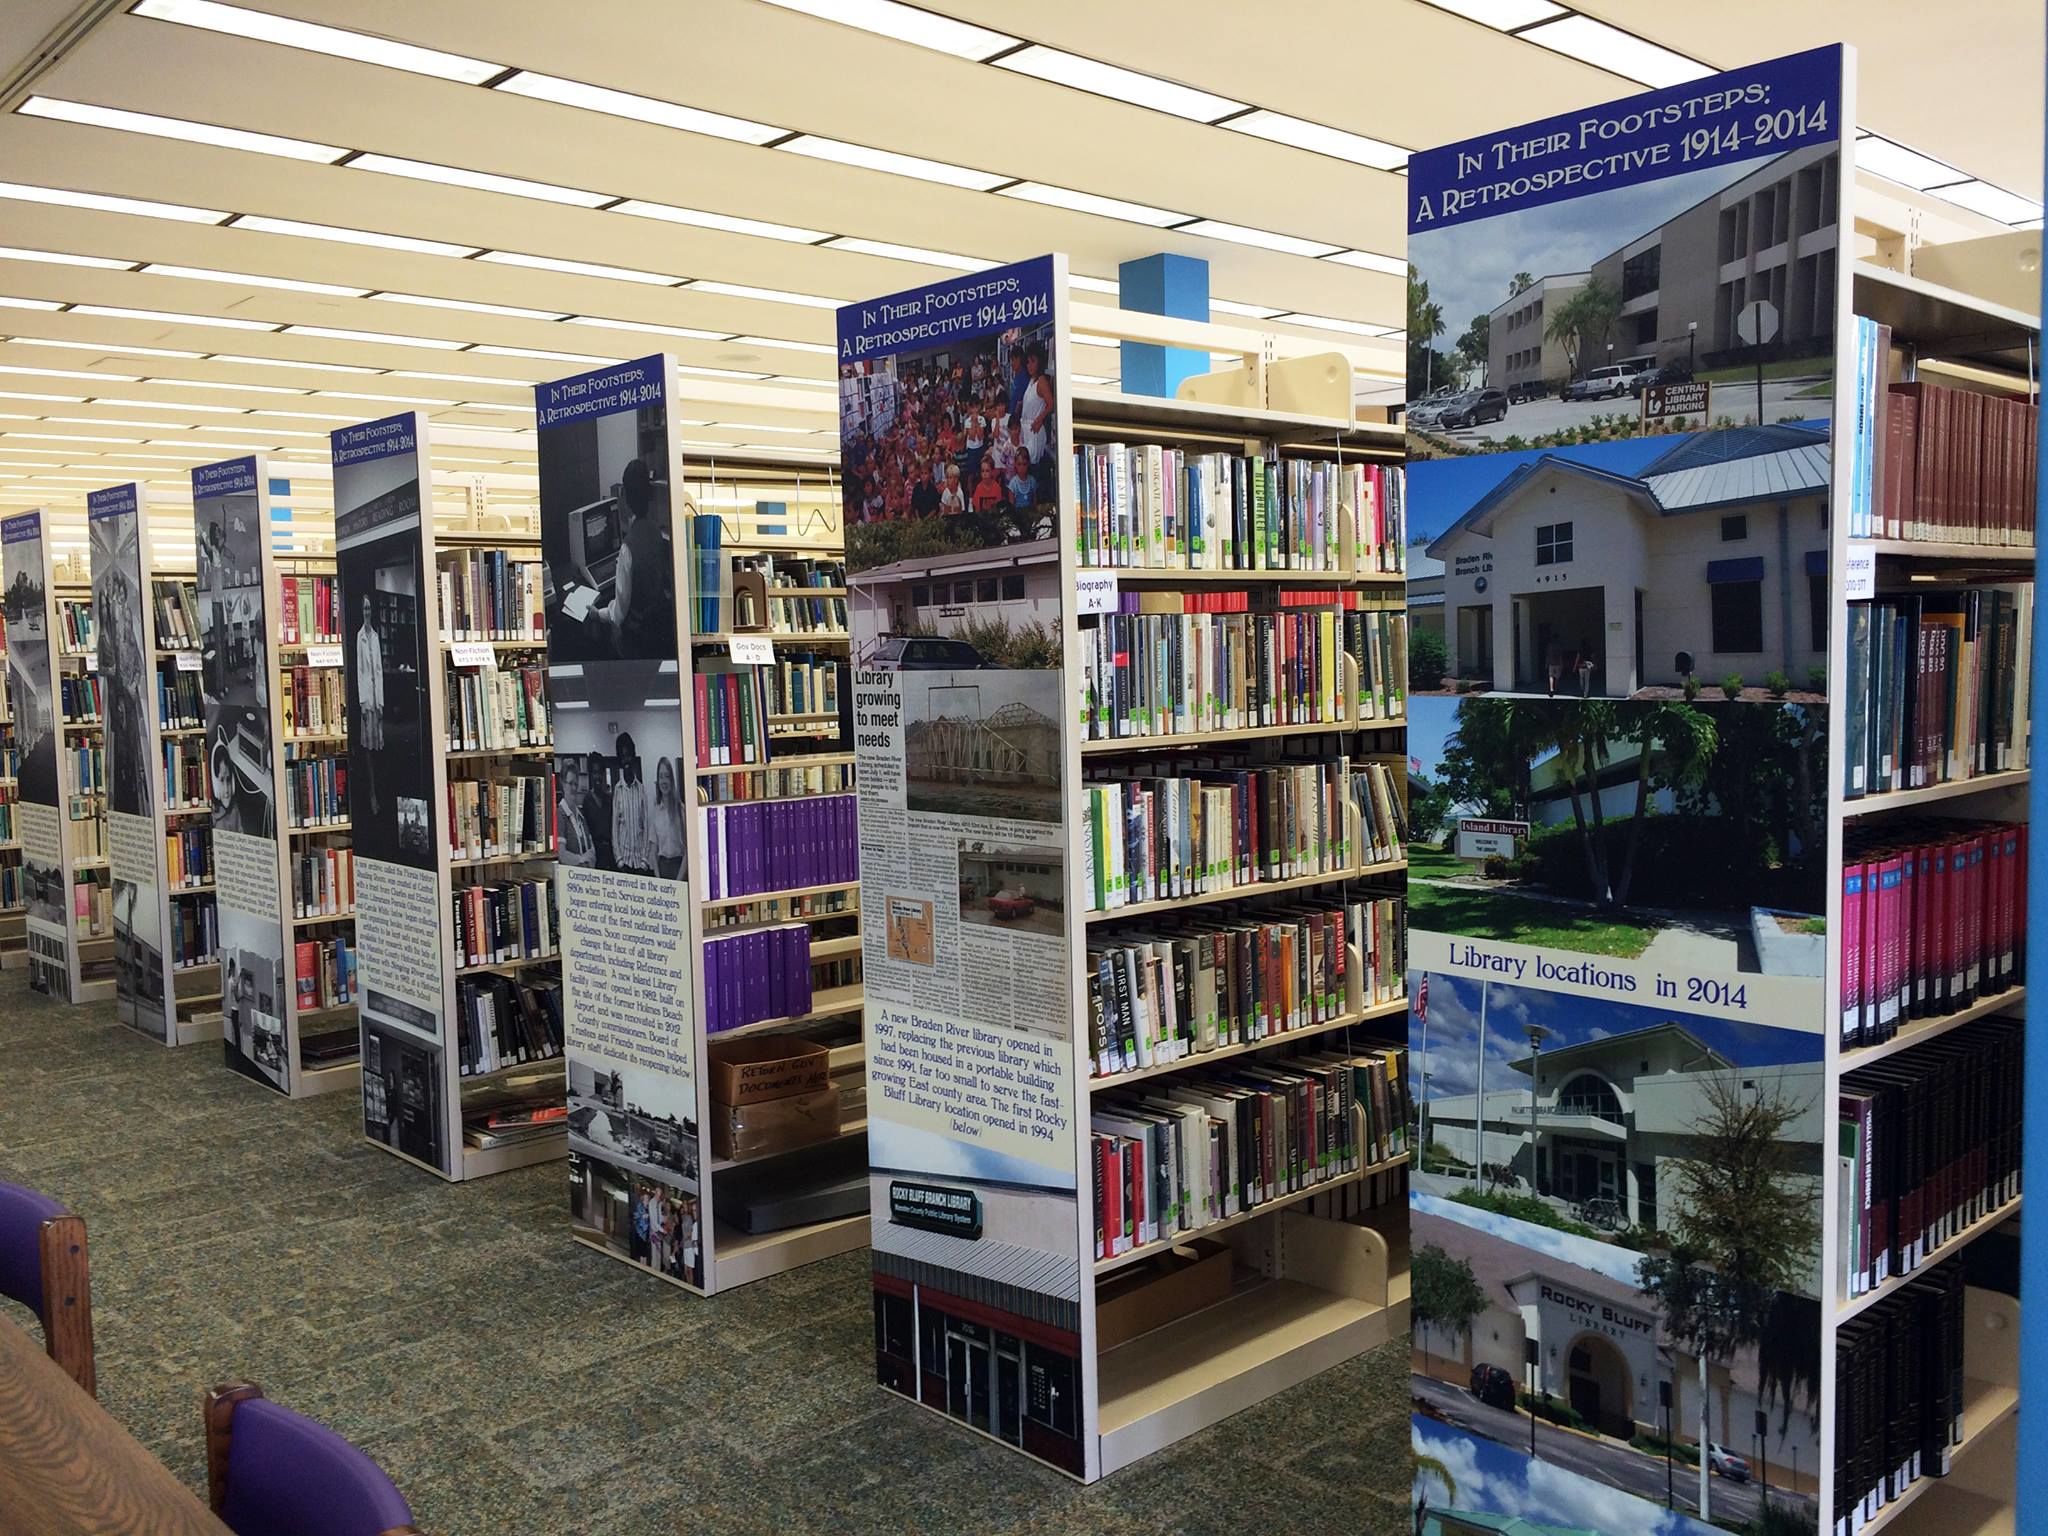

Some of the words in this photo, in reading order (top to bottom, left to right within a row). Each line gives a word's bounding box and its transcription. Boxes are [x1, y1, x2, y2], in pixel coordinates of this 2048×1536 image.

[1457, 152, 1483, 179] IN
[1492, 133, 1570, 170] THEIR
[1580, 84, 1770, 149] FOOTSTEPS:
[1416, 196, 1434, 223] A
[1442, 144, 1669, 216] RETROSPECTIVE
[1681, 100, 1827, 162] 1914-2014
[842, 339, 852, 357] A
[856, 314, 972, 353] RETROSPECTIVE
[977, 293, 1048, 328] 1914-2014
[863, 310, 876, 328] IN
[881, 302, 920, 324] THEIR
[925, 278, 1020, 314] FOOTSTEPS:
[1665, 393, 1704, 404] LIBRARY
[1665, 402, 1704, 413] PARKING
[1666, 384, 1707, 395] CENTRAL
[856, 671, 893, 688] Library
[857, 692, 901, 709] growing
[857, 713, 867, 726] to
[871, 714, 898, 727] meet
[858, 732, 890, 747] needs
[1463, 822, 1489, 832] Island
[1117, 969, 1128, 998] FIRST
[1450, 943, 1527, 980] Library
[1536, 957, 1636, 993] locations
[1657, 971, 1678, 999] in
[1688, 978, 1747, 1010] 2014
[881, 1009, 888, 1020] A
[892, 1014, 908, 1024] new
[912, 1015, 943, 1032] Braden
[946, 1022, 969, 1037] River
[973, 1027, 1003, 1048] library
[1007, 1039, 1040, 1054] opened
[1044, 1044, 1053, 1056] in
[1095, 1002, 1107, 1047] POPS
[1120, 1002, 1131, 1025] MAN
[881, 1040, 896, 1052] had
[900, 1043, 919, 1058] been
[922, 1048, 952, 1066] housed
[956, 1057, 964, 1068] in
[976, 1064, 1013, 1081] portable
[1017, 1071, 1054, 1093] building
[898, 1031, 936, 1048] replacing
[940, 1037, 953, 1050] the
[957, 1043, 995, 1060] previous
[999, 1050, 1029, 1070] library
[1033, 1060, 1061, 1075] which
[872, 1071, 906, 1087] growing
[909, 1077, 929, 1092] East
[932, 1085, 962, 1102] county
[991, 1097, 1009, 1112] The
[1013, 1103, 1031, 1118] first
[1036, 1108, 1067, 1130] Rocky
[873, 1054, 894, 1068] since
[920, 1064, 932, 1076] far
[936, 1068, 950, 1081] too
[953, 1072, 977, 1088] small
[981, 1079, 990, 1091] to
[993, 1085, 1018, 1098] serve
[1022, 1089, 1037, 1103] the
[884, 1086, 905, 1101] Bluff
[909, 1092, 941, 1112] Library
[945, 1101, 980, 1121] location
[983, 1114, 1015, 1130] opened
[1019, 1121, 1027, 1134] in
[1031, 1125, 1053, 1141] 1994
[1541, 1286, 1595, 1314] ROCKY
[1602, 1307, 1652, 1333] BLUFF
